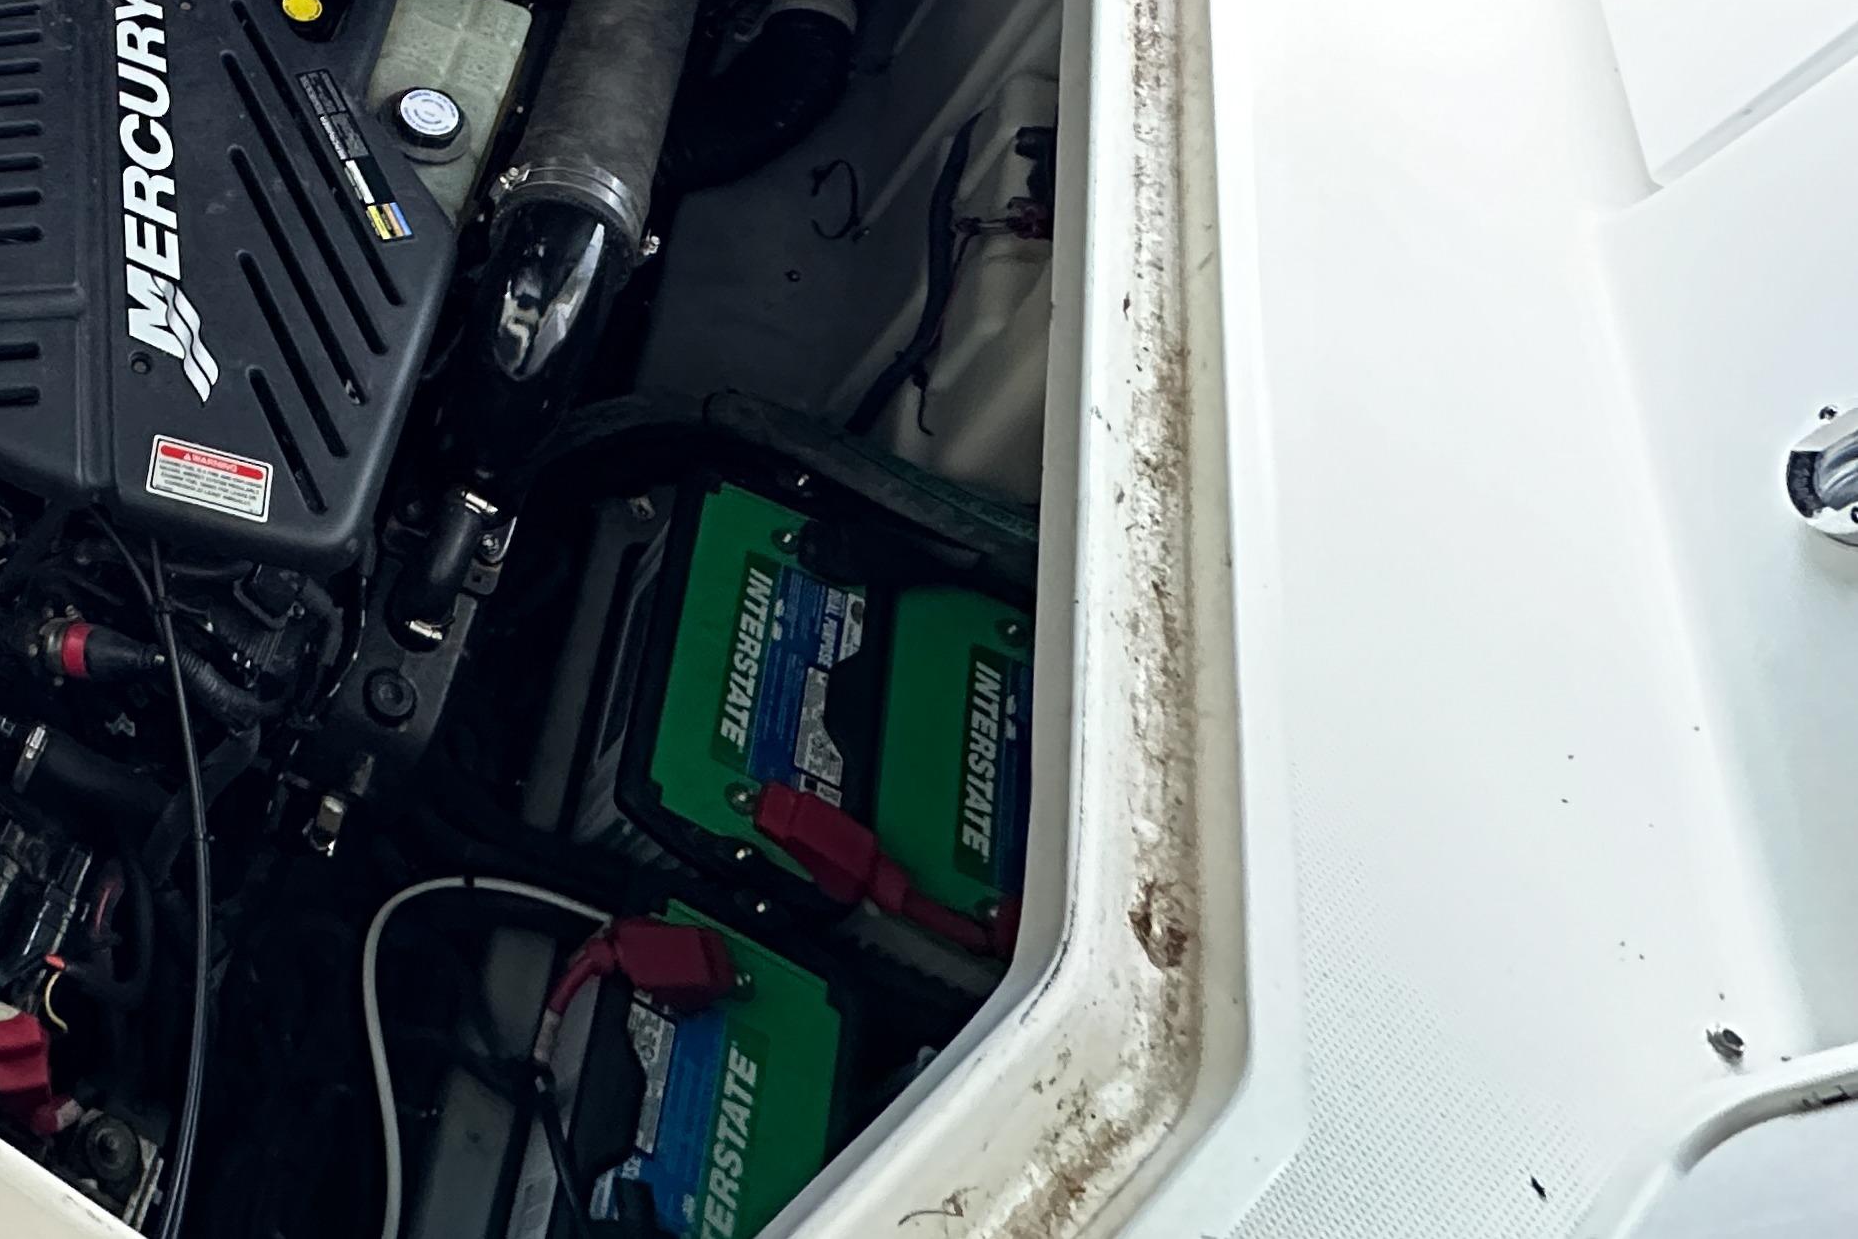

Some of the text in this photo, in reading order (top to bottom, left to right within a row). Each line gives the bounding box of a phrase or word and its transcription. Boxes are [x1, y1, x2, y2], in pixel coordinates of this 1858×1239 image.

[191, 452, 238, 473] WARNING
[719, 567, 775, 754] INTERSTATE
[961, 660, 1003, 859] INTERSTATE
